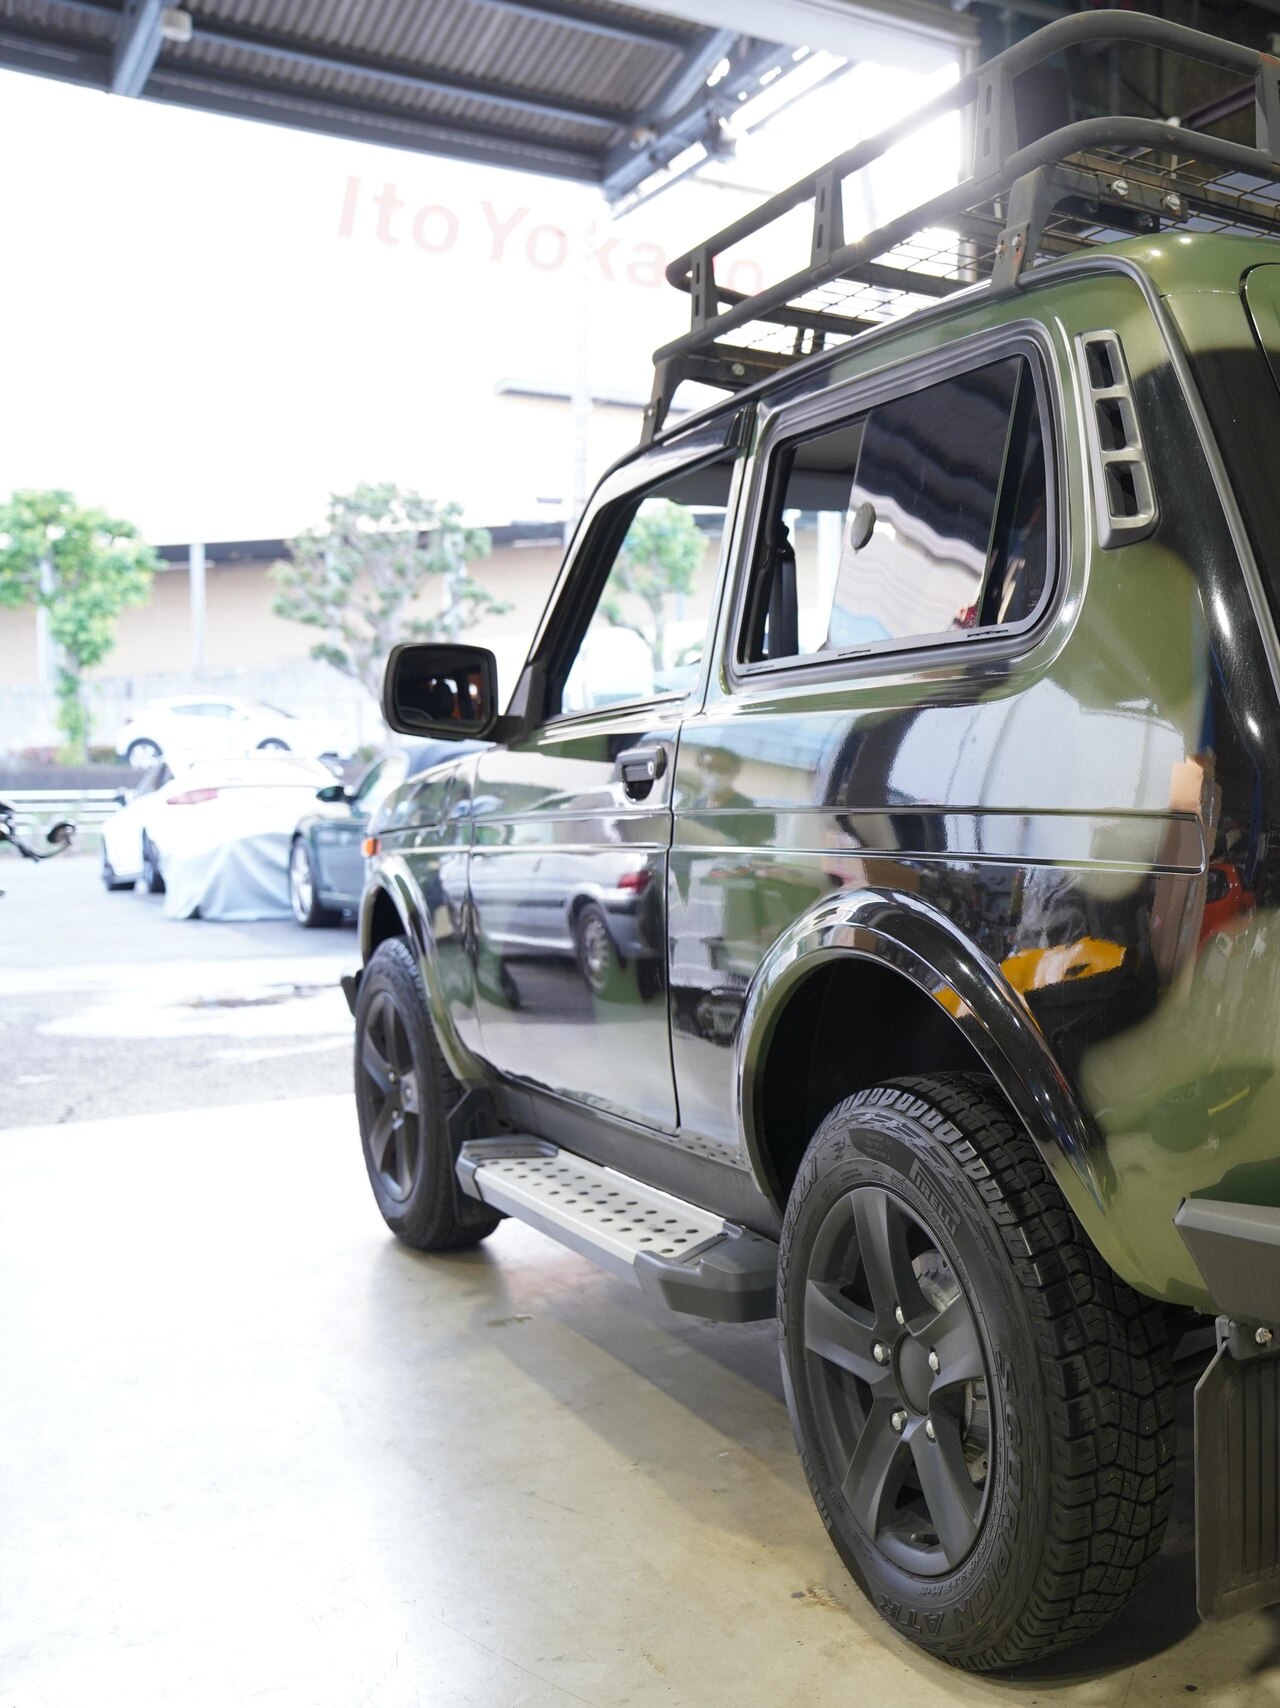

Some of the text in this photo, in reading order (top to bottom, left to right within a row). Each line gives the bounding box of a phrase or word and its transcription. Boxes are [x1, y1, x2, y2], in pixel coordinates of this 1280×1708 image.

[336, 174, 767, 297] Ito Yokao
[909, 1158, 962, 1237] PIRELLI
[953, 1349, 1022, 1633] SCORPION
[879, 1593, 946, 1636] ATR
